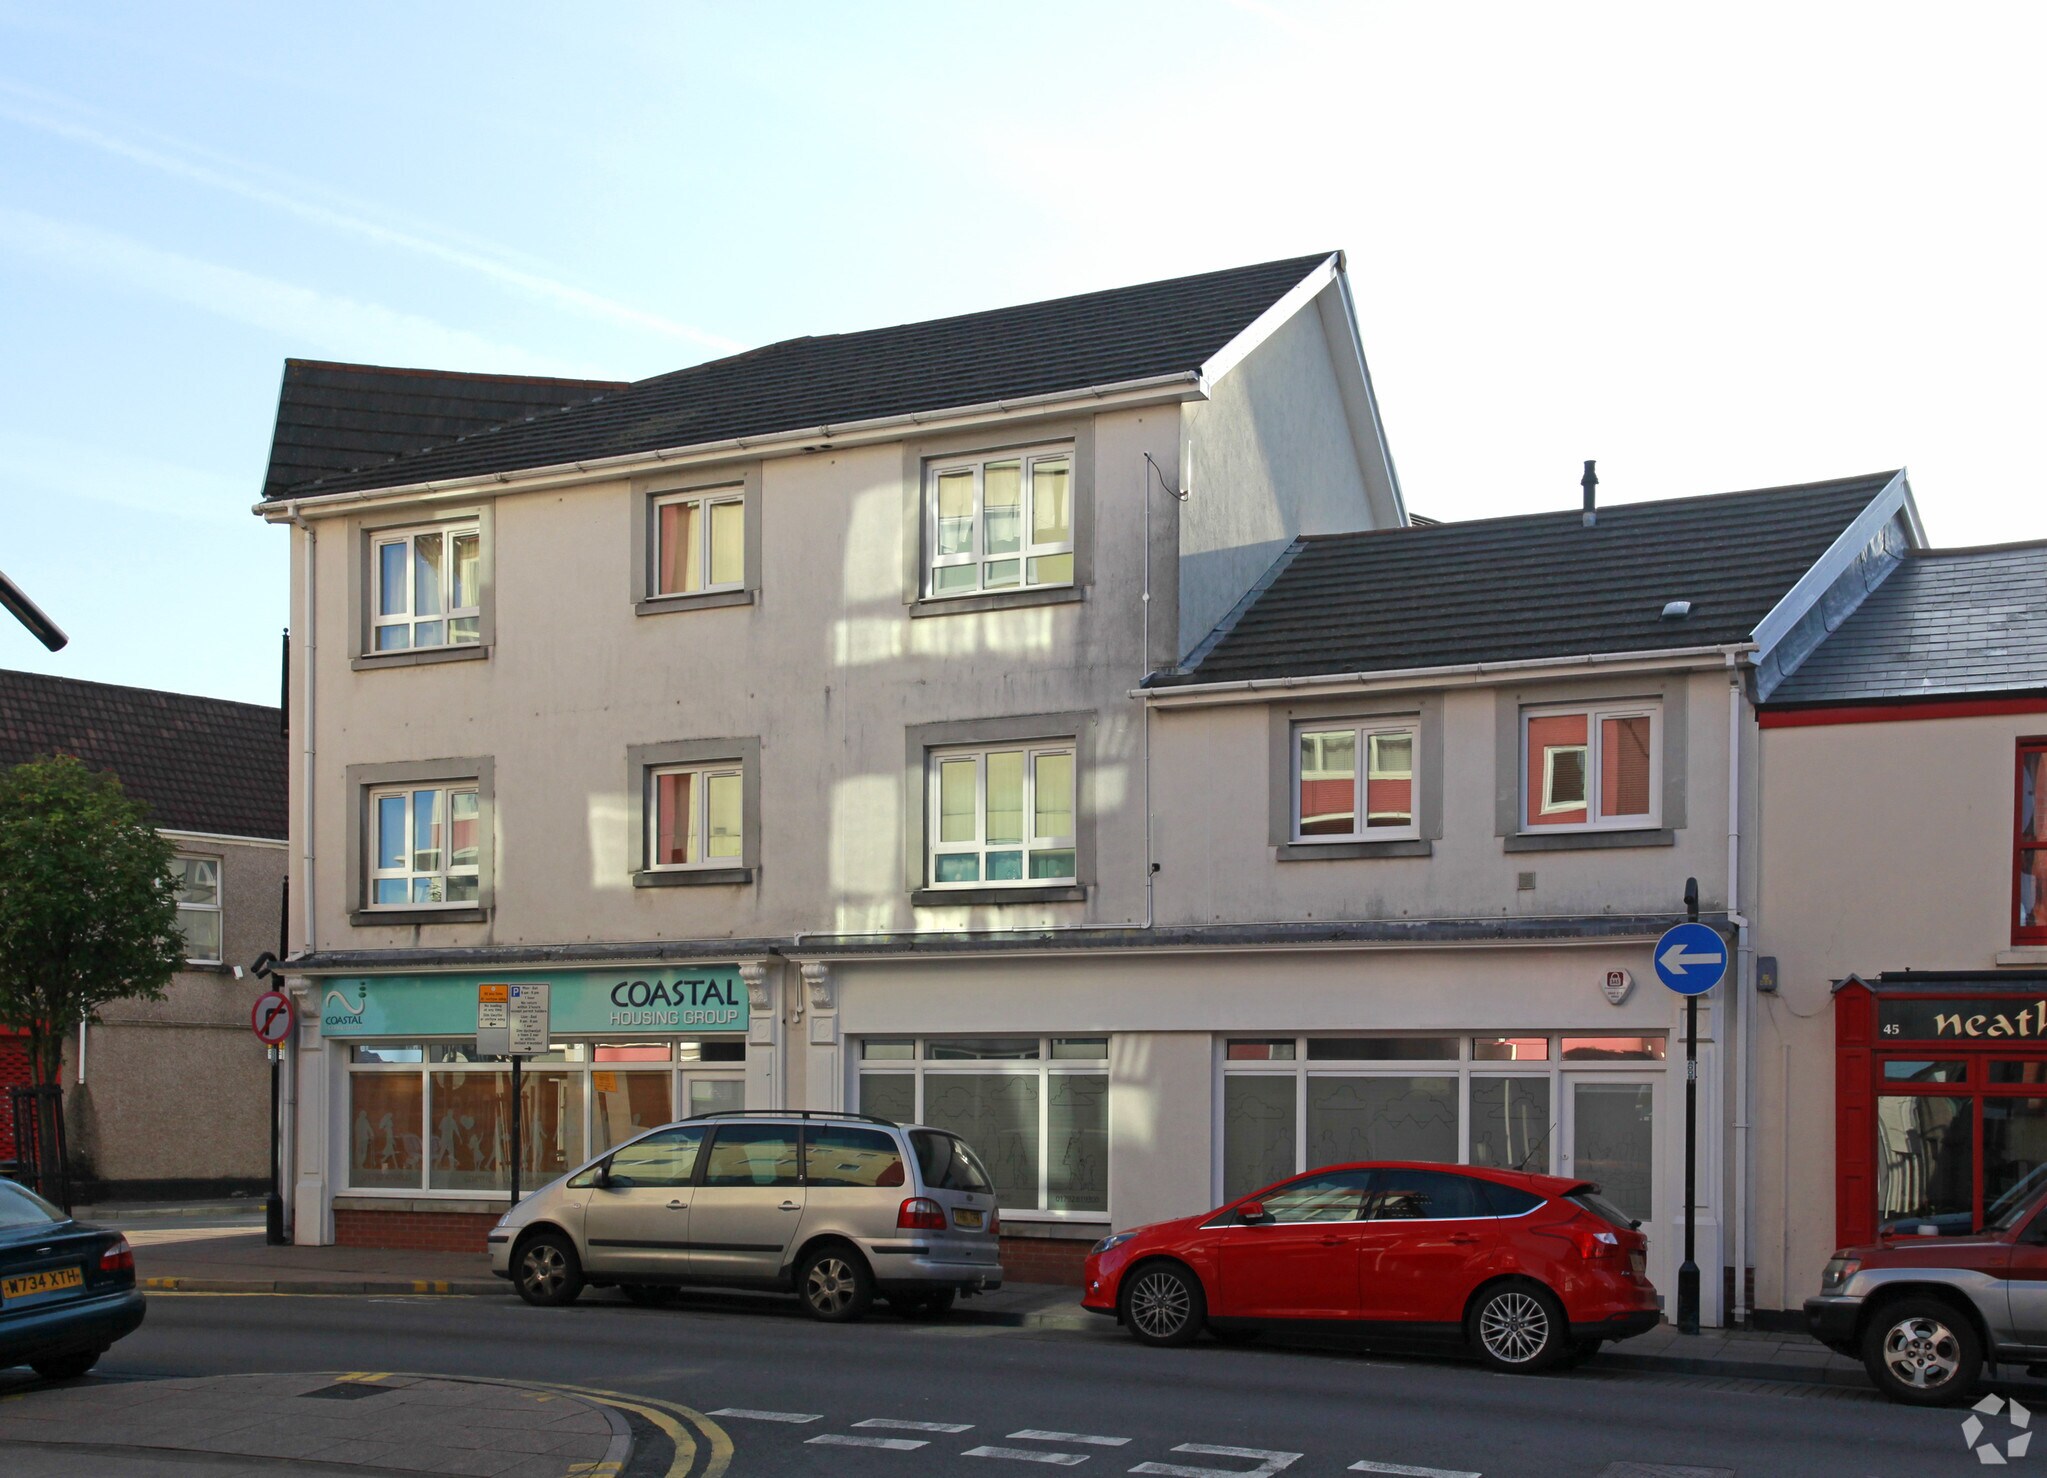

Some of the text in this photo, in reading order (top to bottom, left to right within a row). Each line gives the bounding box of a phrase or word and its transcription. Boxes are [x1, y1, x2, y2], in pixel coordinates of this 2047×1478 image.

[610, 978, 739, 1007] COASTAL
[325, 1015, 363, 1025] COASTAL
[610, 1009, 739, 1025] HOUSING GROUP
[1883, 1024, 1900, 1035] 45
[8, 1273, 47, 1294] W734
[49, 1269, 76, 1286] XTH
